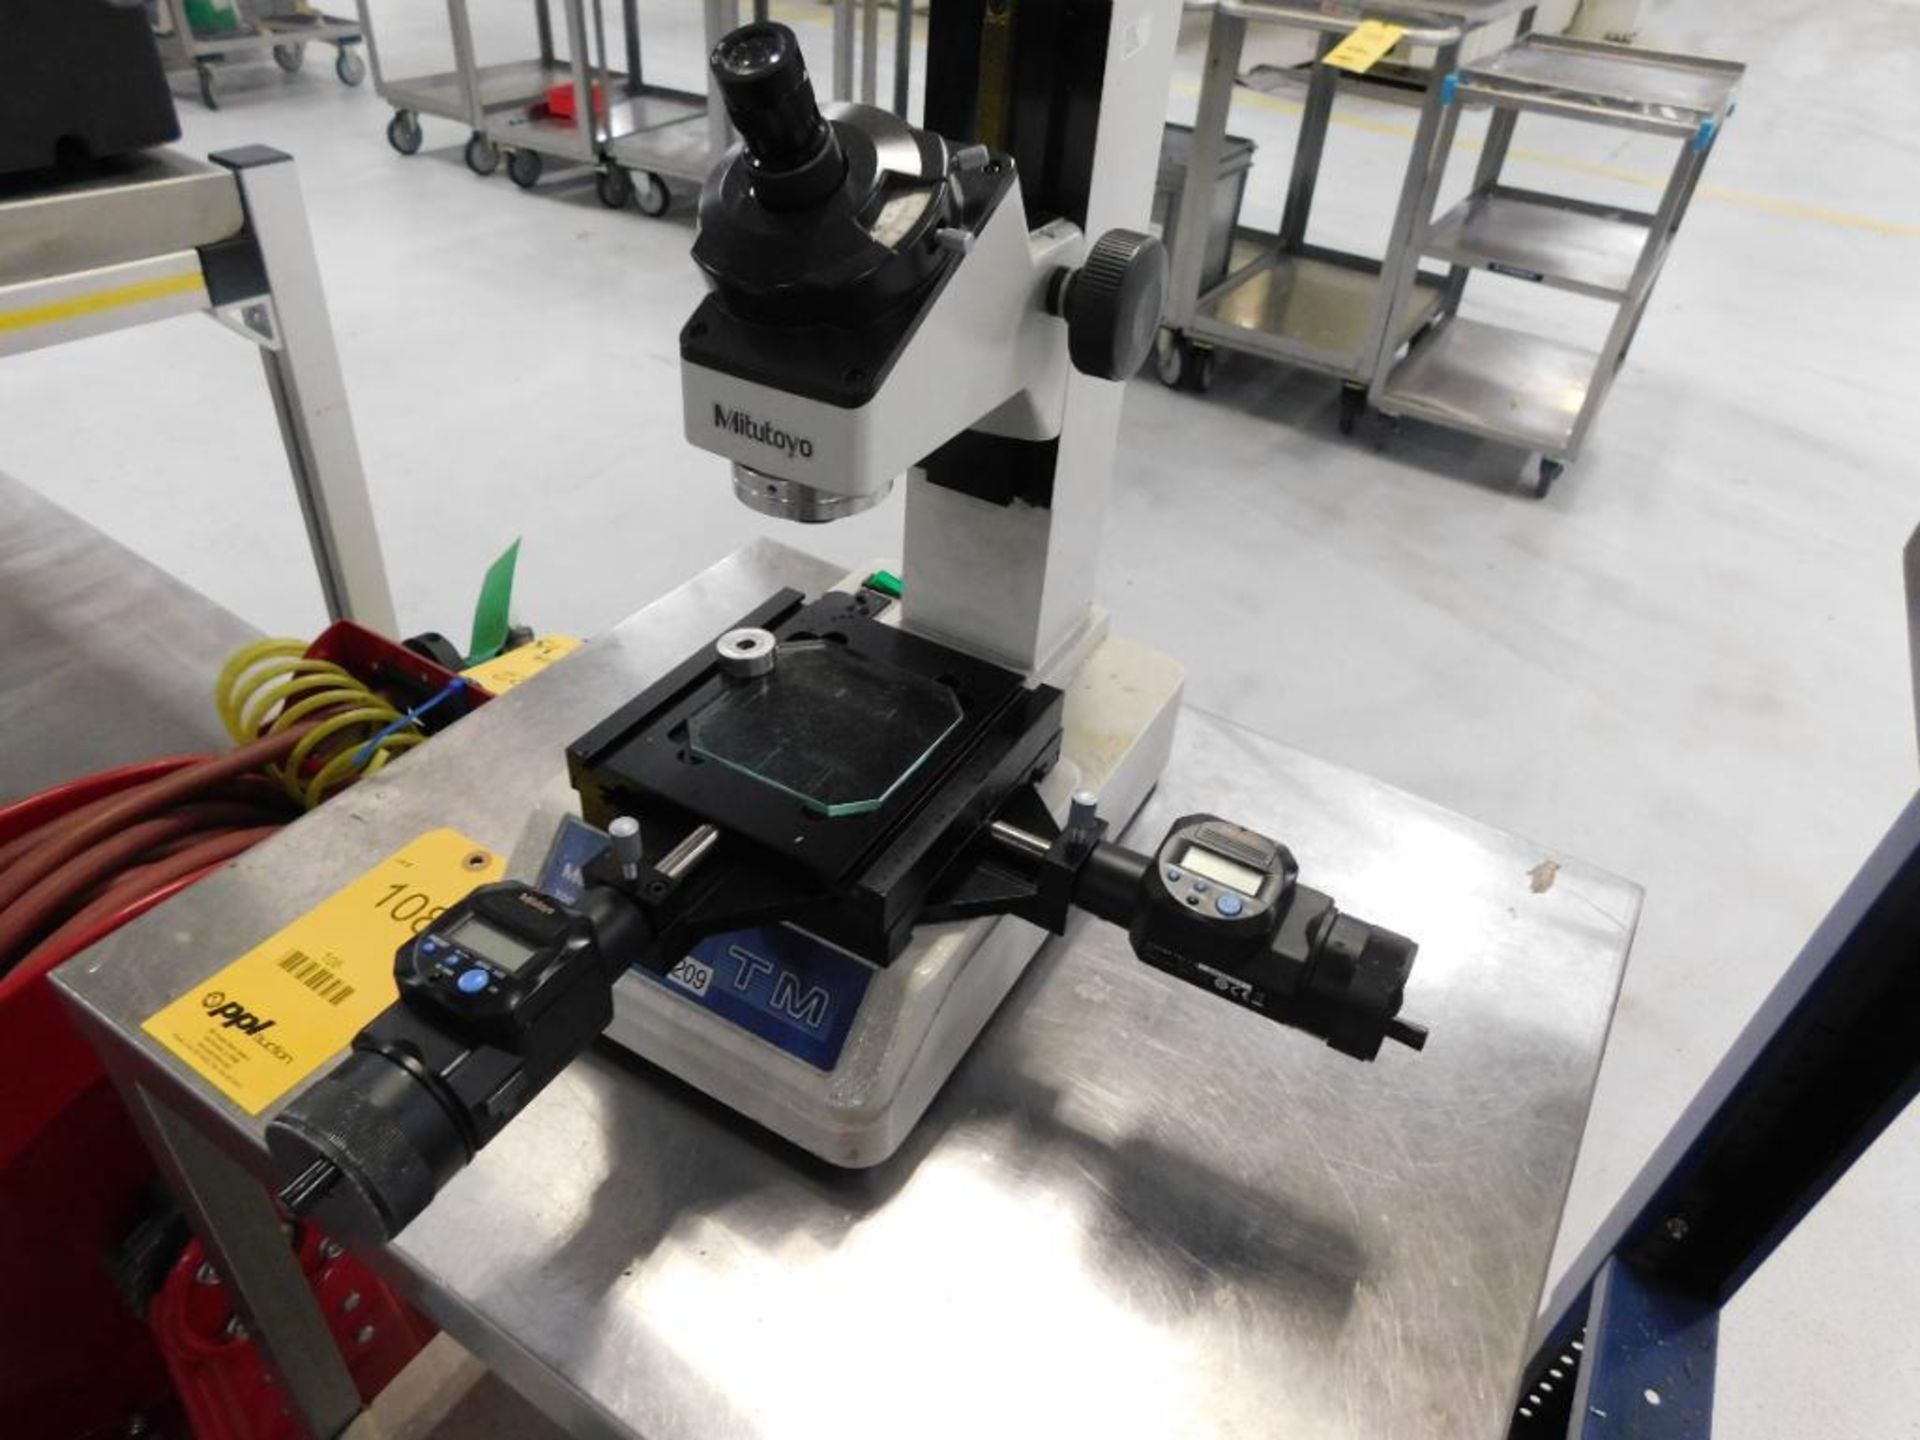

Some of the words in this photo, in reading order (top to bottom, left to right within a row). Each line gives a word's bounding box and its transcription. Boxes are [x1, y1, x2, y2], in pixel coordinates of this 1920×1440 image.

[713, 403, 813, 458] Mitutoyo
[671, 960, 707, 989] 209
[728, 944, 830, 1028] TM
